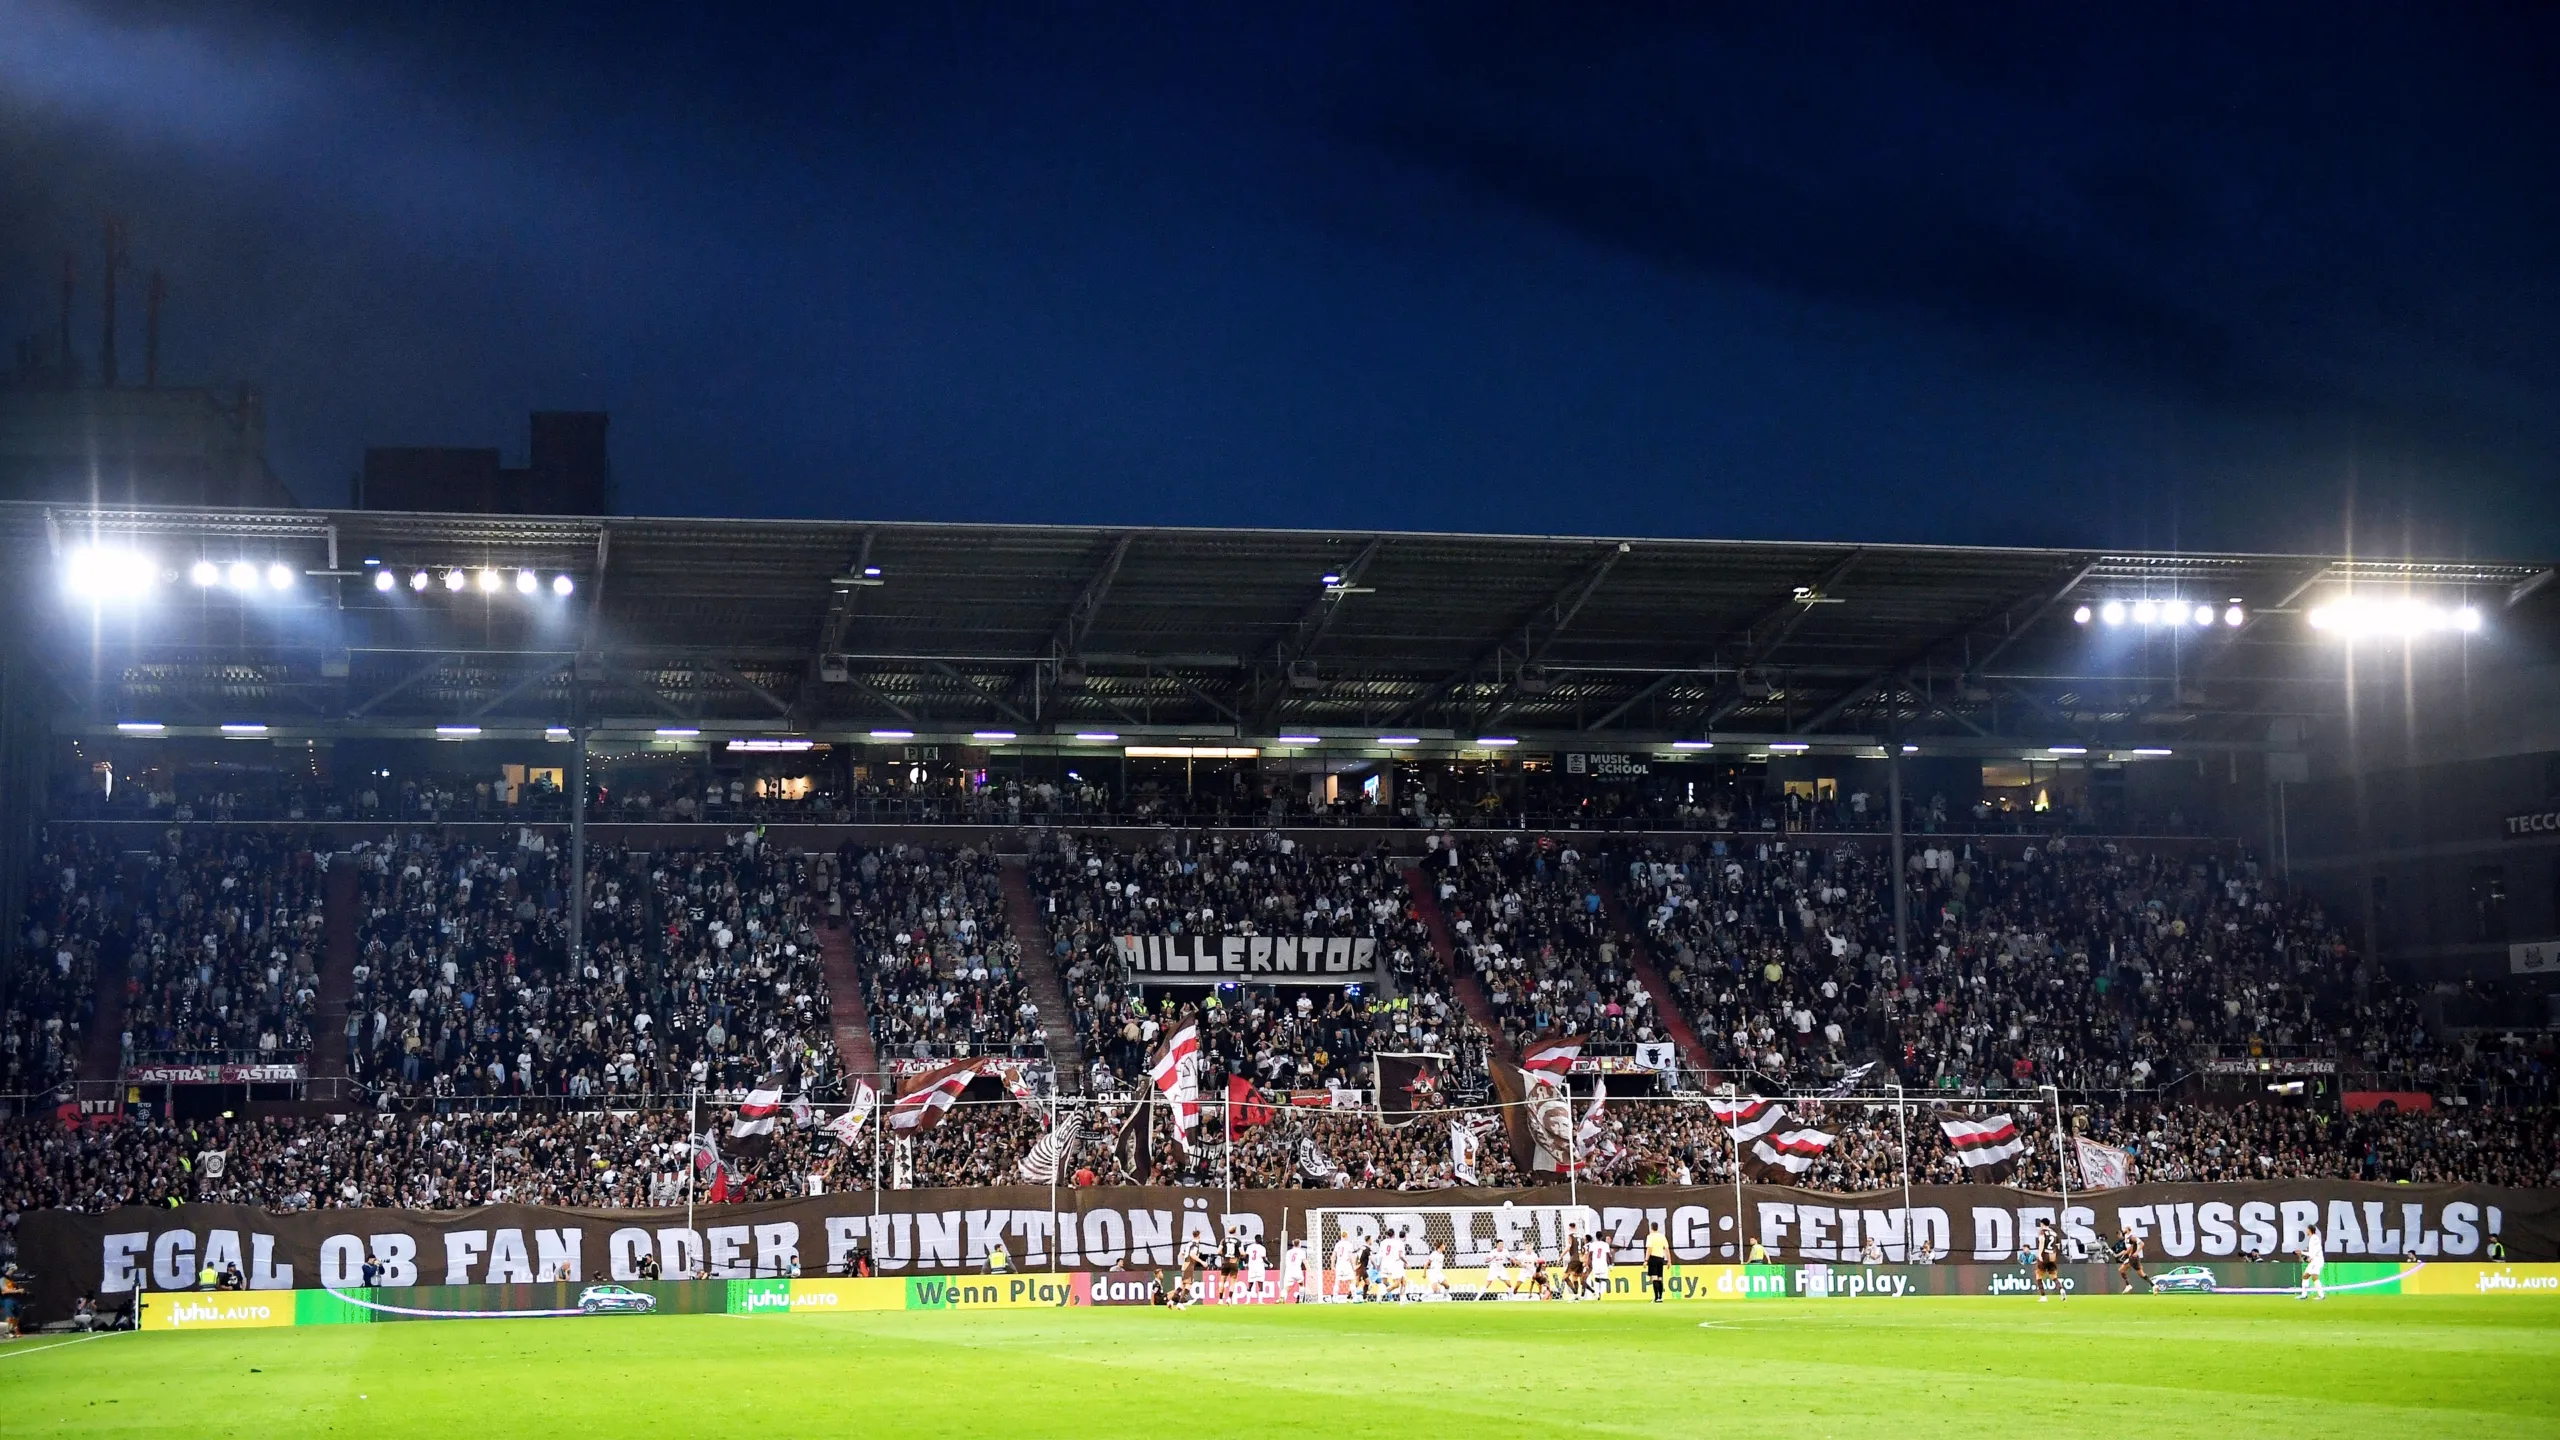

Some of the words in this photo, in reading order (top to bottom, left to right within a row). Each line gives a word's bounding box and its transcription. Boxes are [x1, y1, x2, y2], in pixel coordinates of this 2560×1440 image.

[1590, 754, 1630, 764] MUSIC
[1598, 764, 1649, 775] SCHOOL
[141, 1069, 205, 1081] ASTRA
[236, 1067, 298, 1080] ASTRA
[101, 1229, 293, 1293] EGAL
[320, 1233, 418, 1288] OB
[444, 1228, 582, 1285] FAN
[609, 1221, 800, 1281] ODER
[1757, 1202, 1950, 1263] FEIND
[2118, 1200, 2502, 1260] FUSSBALLS!
[2047, 1236, 2055, 1249] 2
[1251, 1250, 1257, 1261] 3
[1386, 1245, 1392, 1256] 9
[1641, 1271, 1707, 1298] Pay,
[1717, 1269, 1786, 1293] dann
[1795, 1269, 1916, 1297] Fairplay.
[916, 1281, 997, 1305] Wenn
[1010, 1279, 1080, 1307] Play,
[1091, 1276, 1153, 1301] dan
